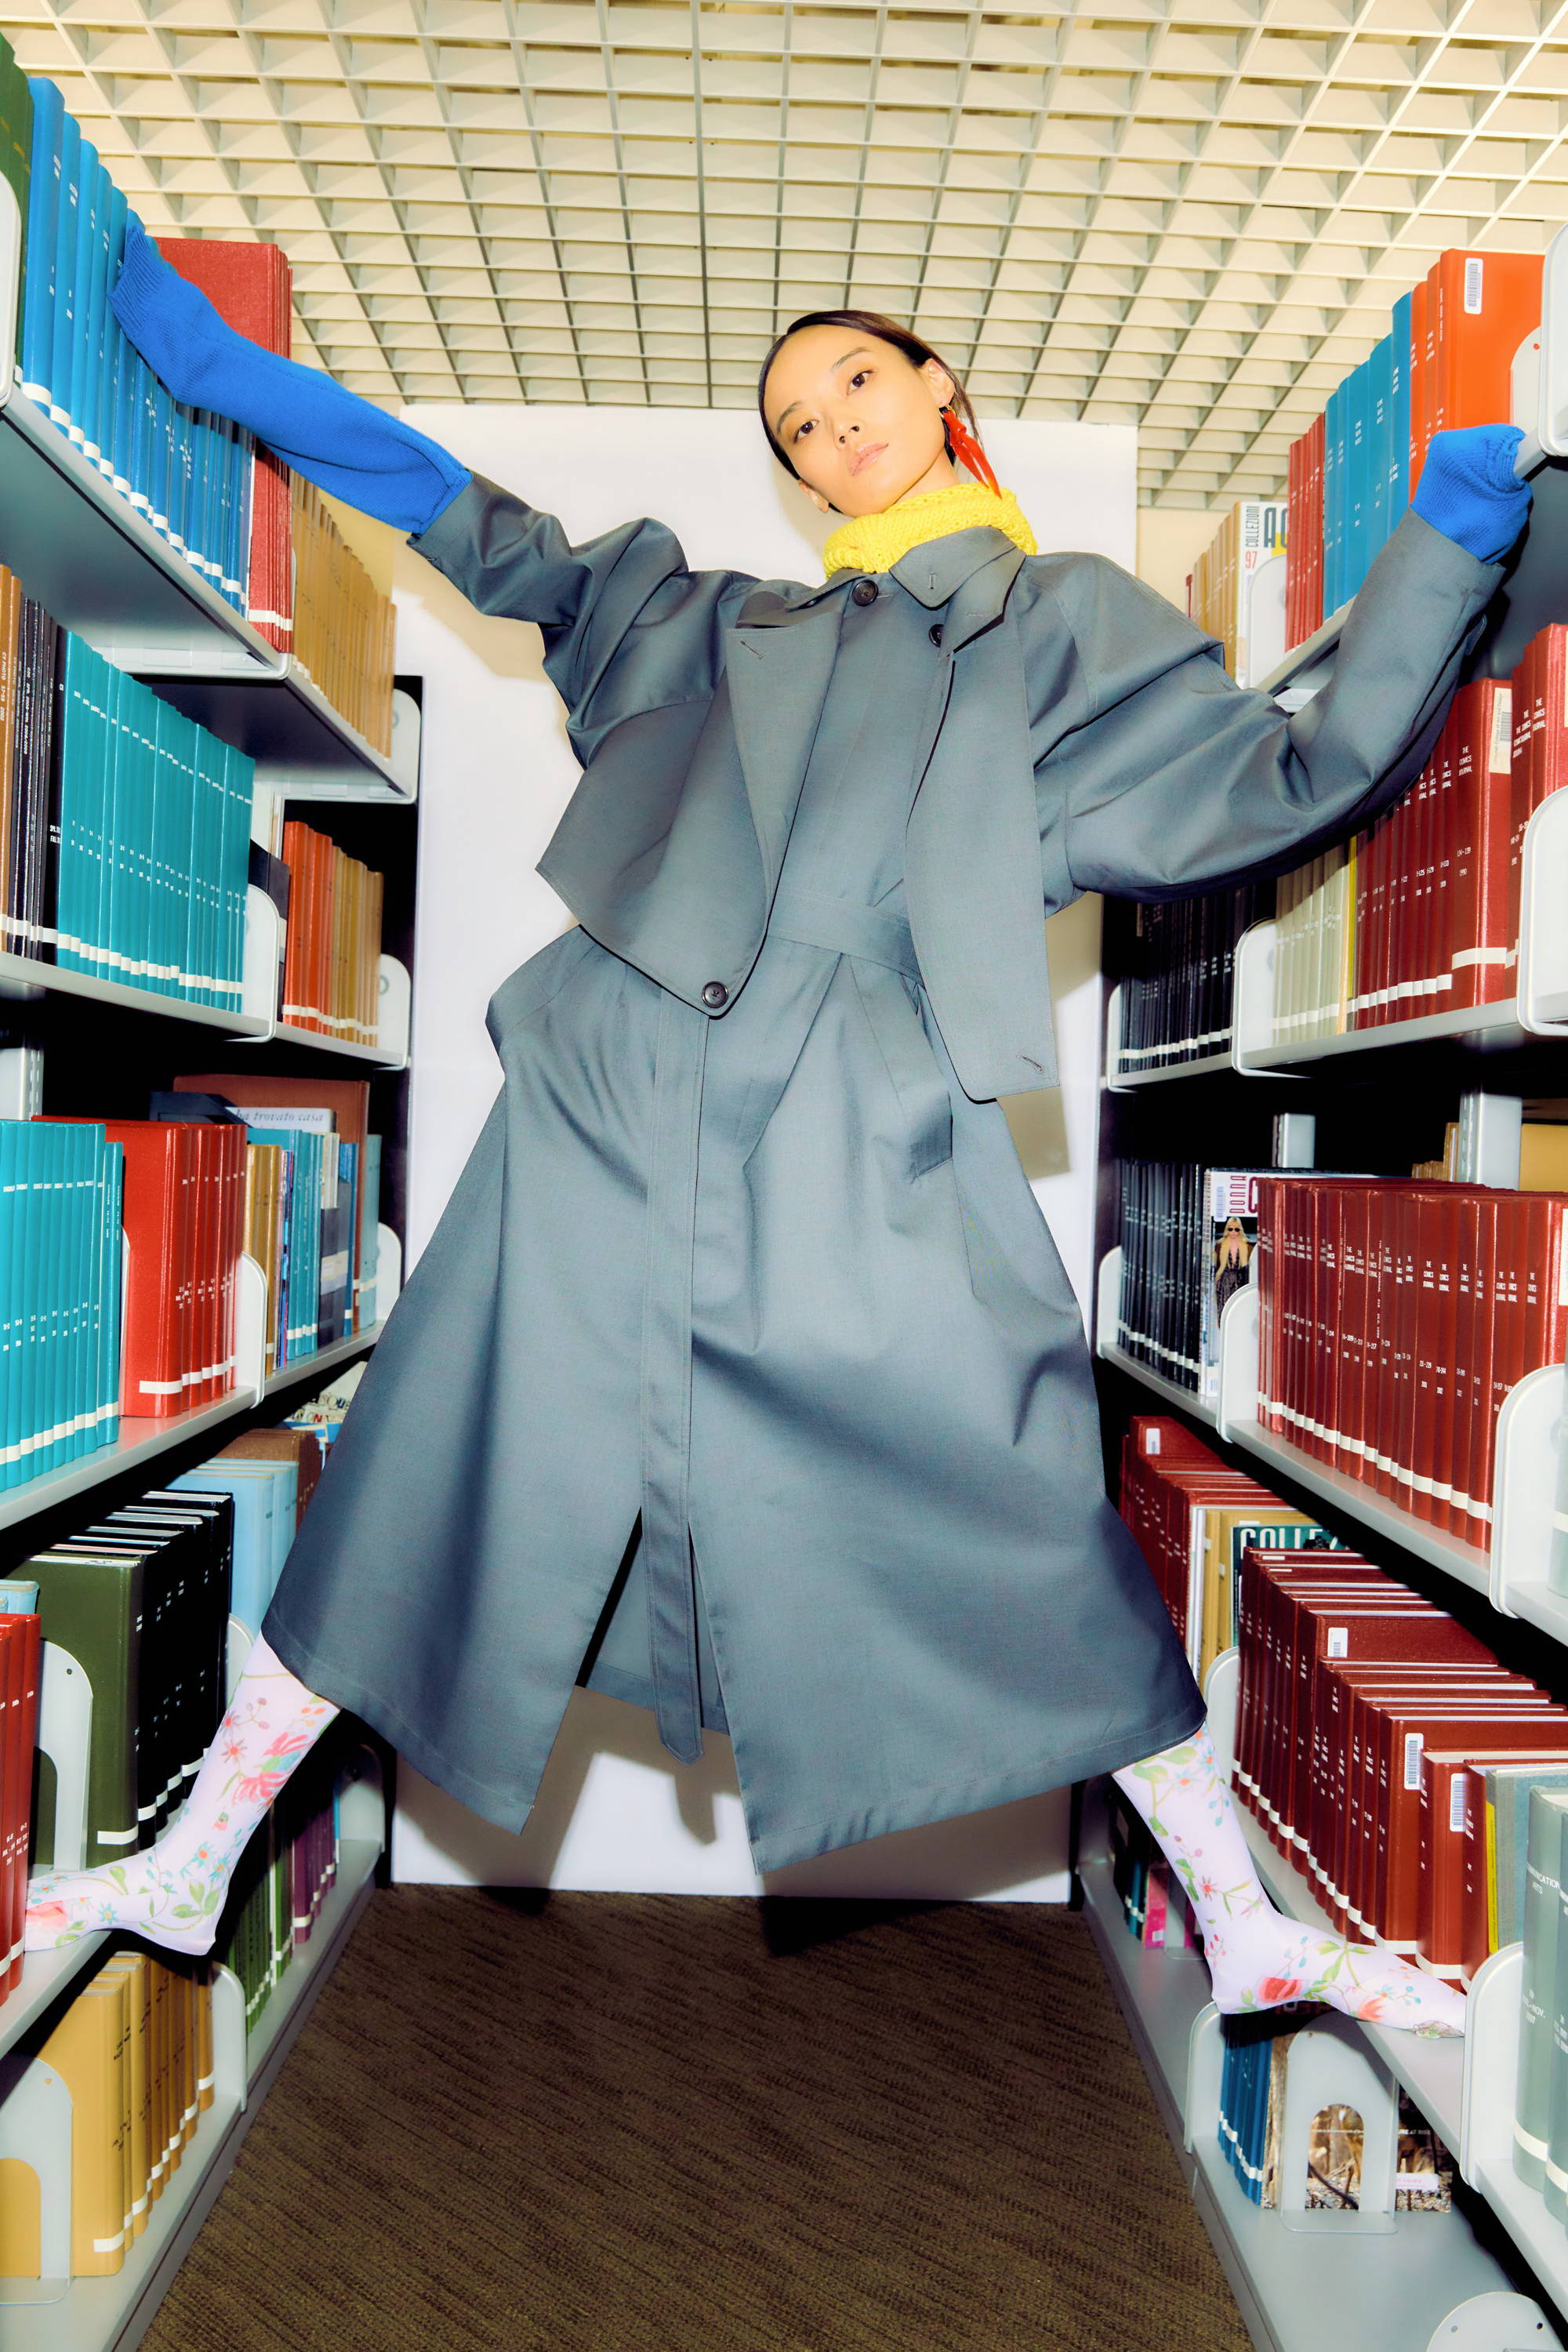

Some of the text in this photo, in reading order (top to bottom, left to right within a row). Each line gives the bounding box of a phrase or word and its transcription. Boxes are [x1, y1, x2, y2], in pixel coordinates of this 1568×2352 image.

[1245, 506, 1260, 547] COLLEZIONI
[1245, 550, 1258, 569] 97
[1459, 755, 1472, 766] COMICS
[1458, 765, 1472, 777] JOURNAL
[253, 1111, 295, 1122] trovato
[298, 1113, 323, 1122] casa
[1229, 1175, 1247, 1214] DONNA
